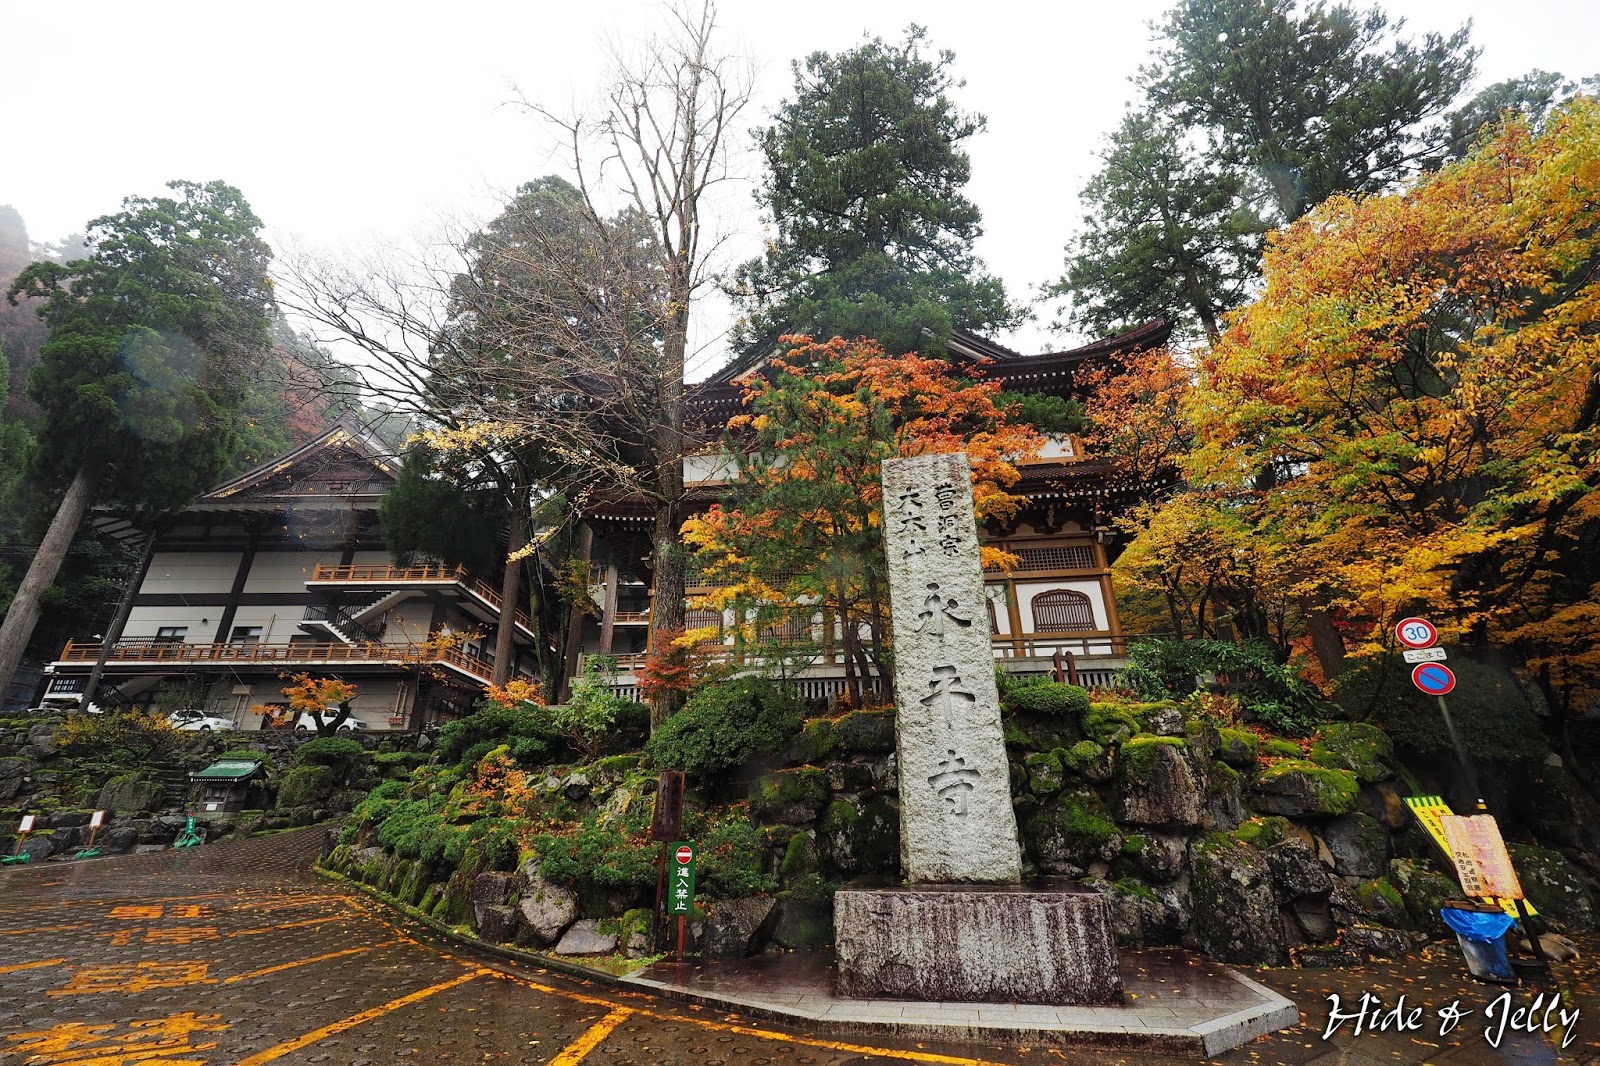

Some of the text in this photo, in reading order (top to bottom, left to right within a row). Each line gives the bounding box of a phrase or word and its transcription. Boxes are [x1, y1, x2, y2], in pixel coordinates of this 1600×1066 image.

[934, 482, 961, 556] 曹洞宗
[1405, 626, 1428, 641] 30
[914, 582, 981, 818] 永平寺
[674, 866, 690, 911] 進入禁止
